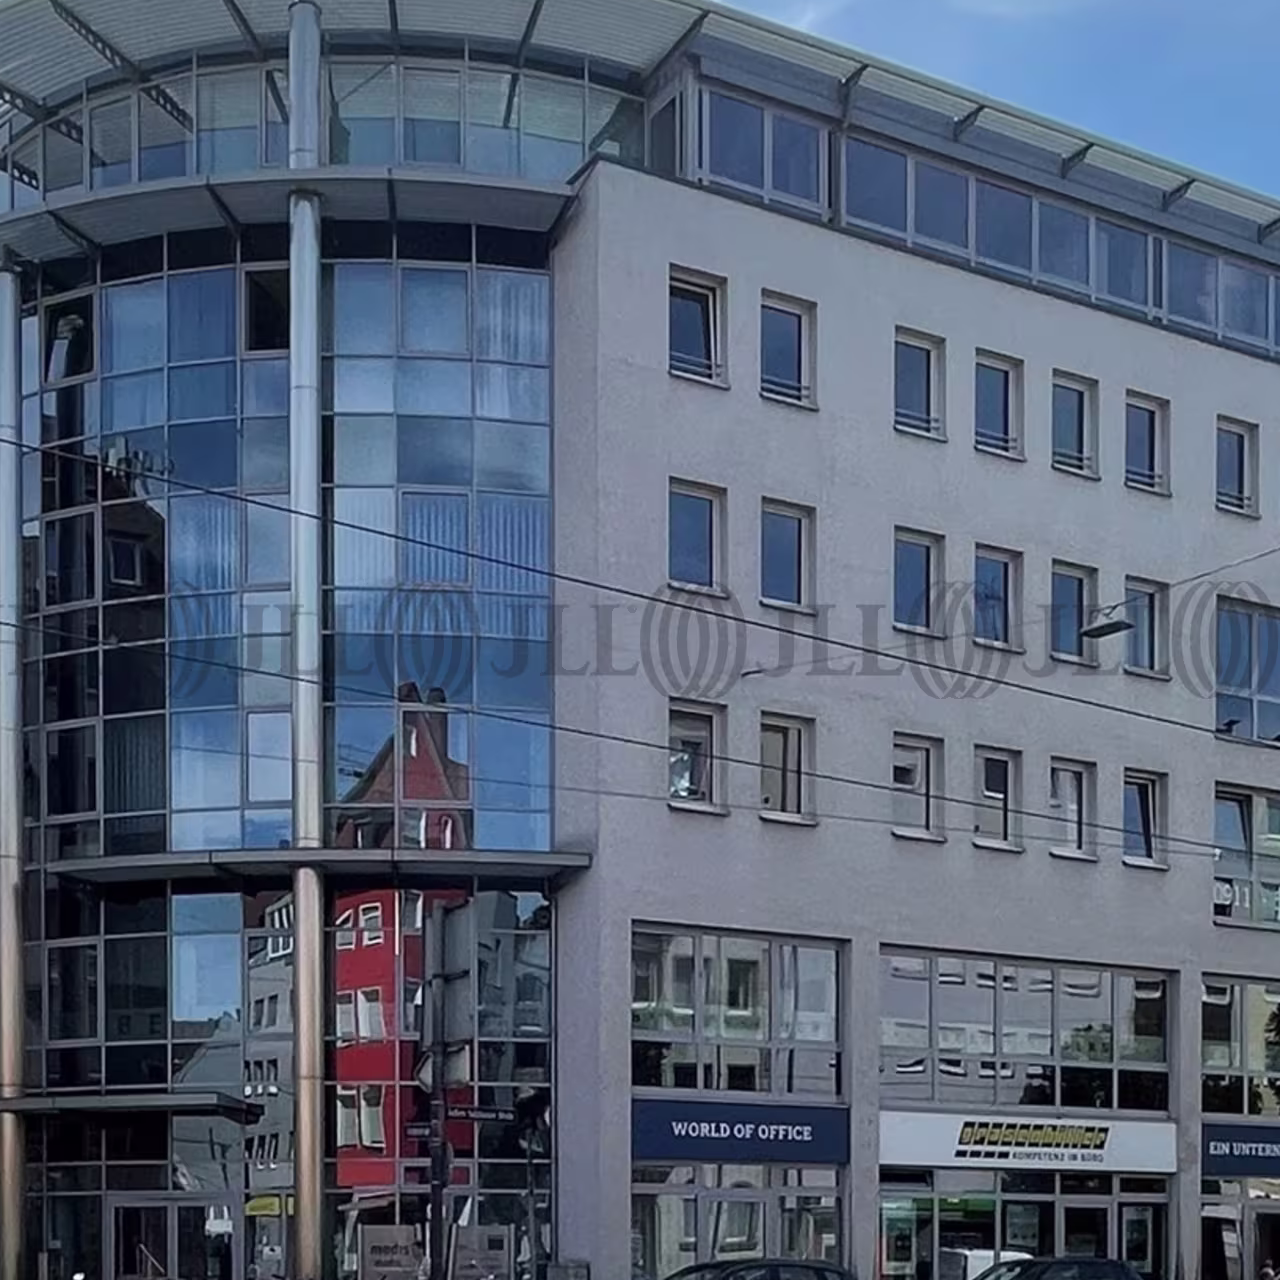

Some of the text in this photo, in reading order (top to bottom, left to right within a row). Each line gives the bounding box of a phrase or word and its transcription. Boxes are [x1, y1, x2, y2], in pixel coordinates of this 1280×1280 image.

[671, 1121, 813, 1141] WORLD OF OFFICE
[1209, 1142, 1230, 1155] EIN
